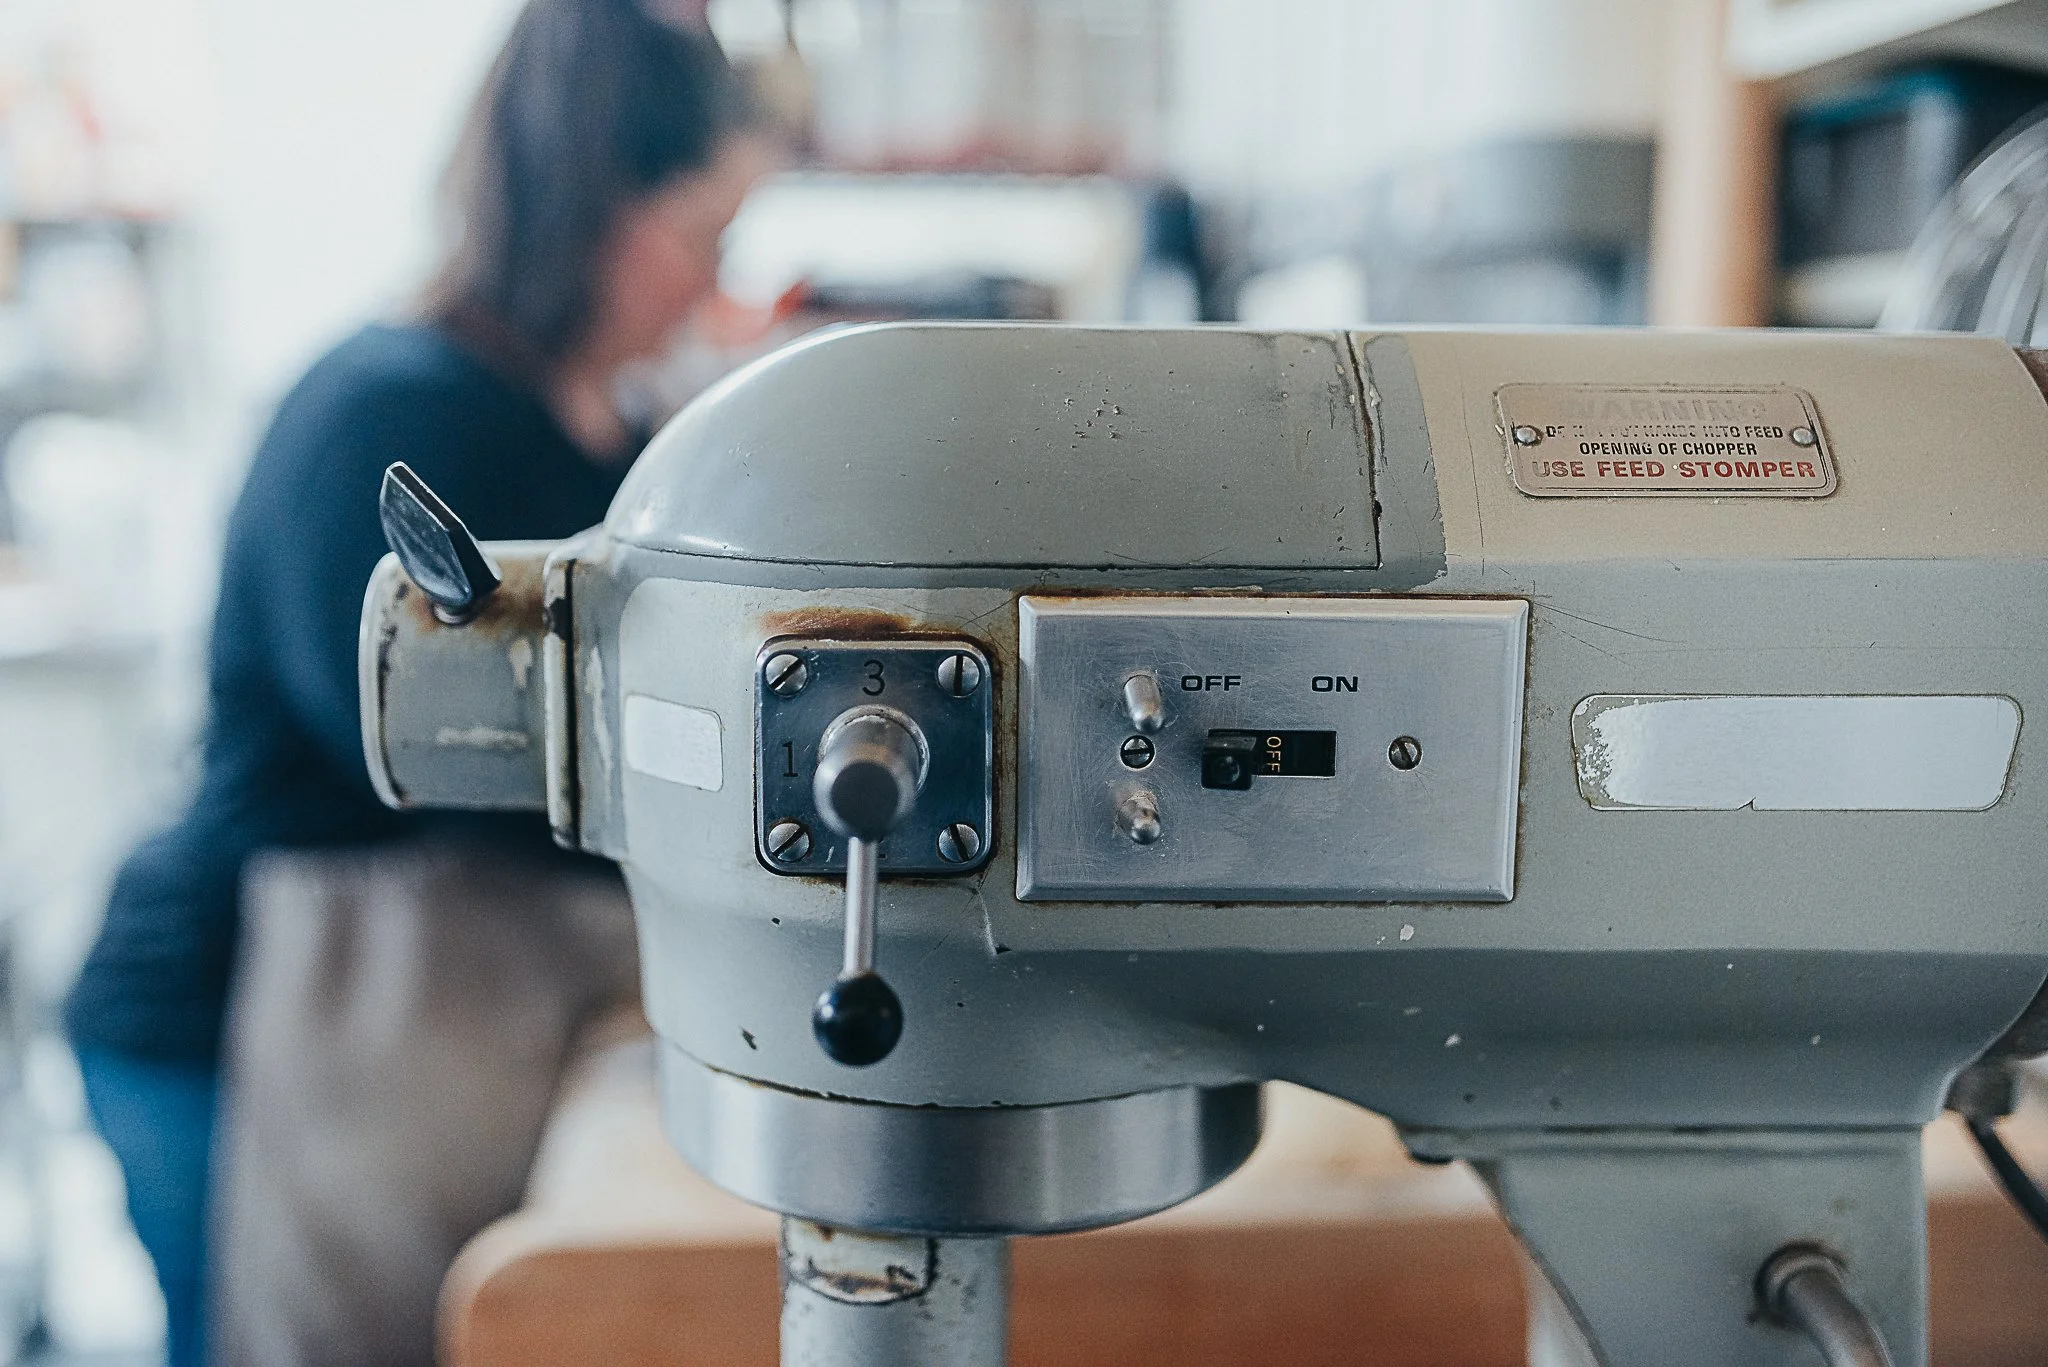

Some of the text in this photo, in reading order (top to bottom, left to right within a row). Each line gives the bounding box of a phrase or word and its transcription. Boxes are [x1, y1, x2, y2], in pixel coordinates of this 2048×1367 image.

[1744, 425, 1784, 438] FEED
[1579, 442, 1758, 456] OPENING OF CHOPPER
[1532, 460, 1816, 478] USE FEED STOMPER
[862, 659, 886, 696] 3
[1181, 675, 1241, 691] OFF
[1311, 676, 1358, 692] ON
[782, 741, 798, 777] 1
[1266, 736, 1281, 773] OFF
